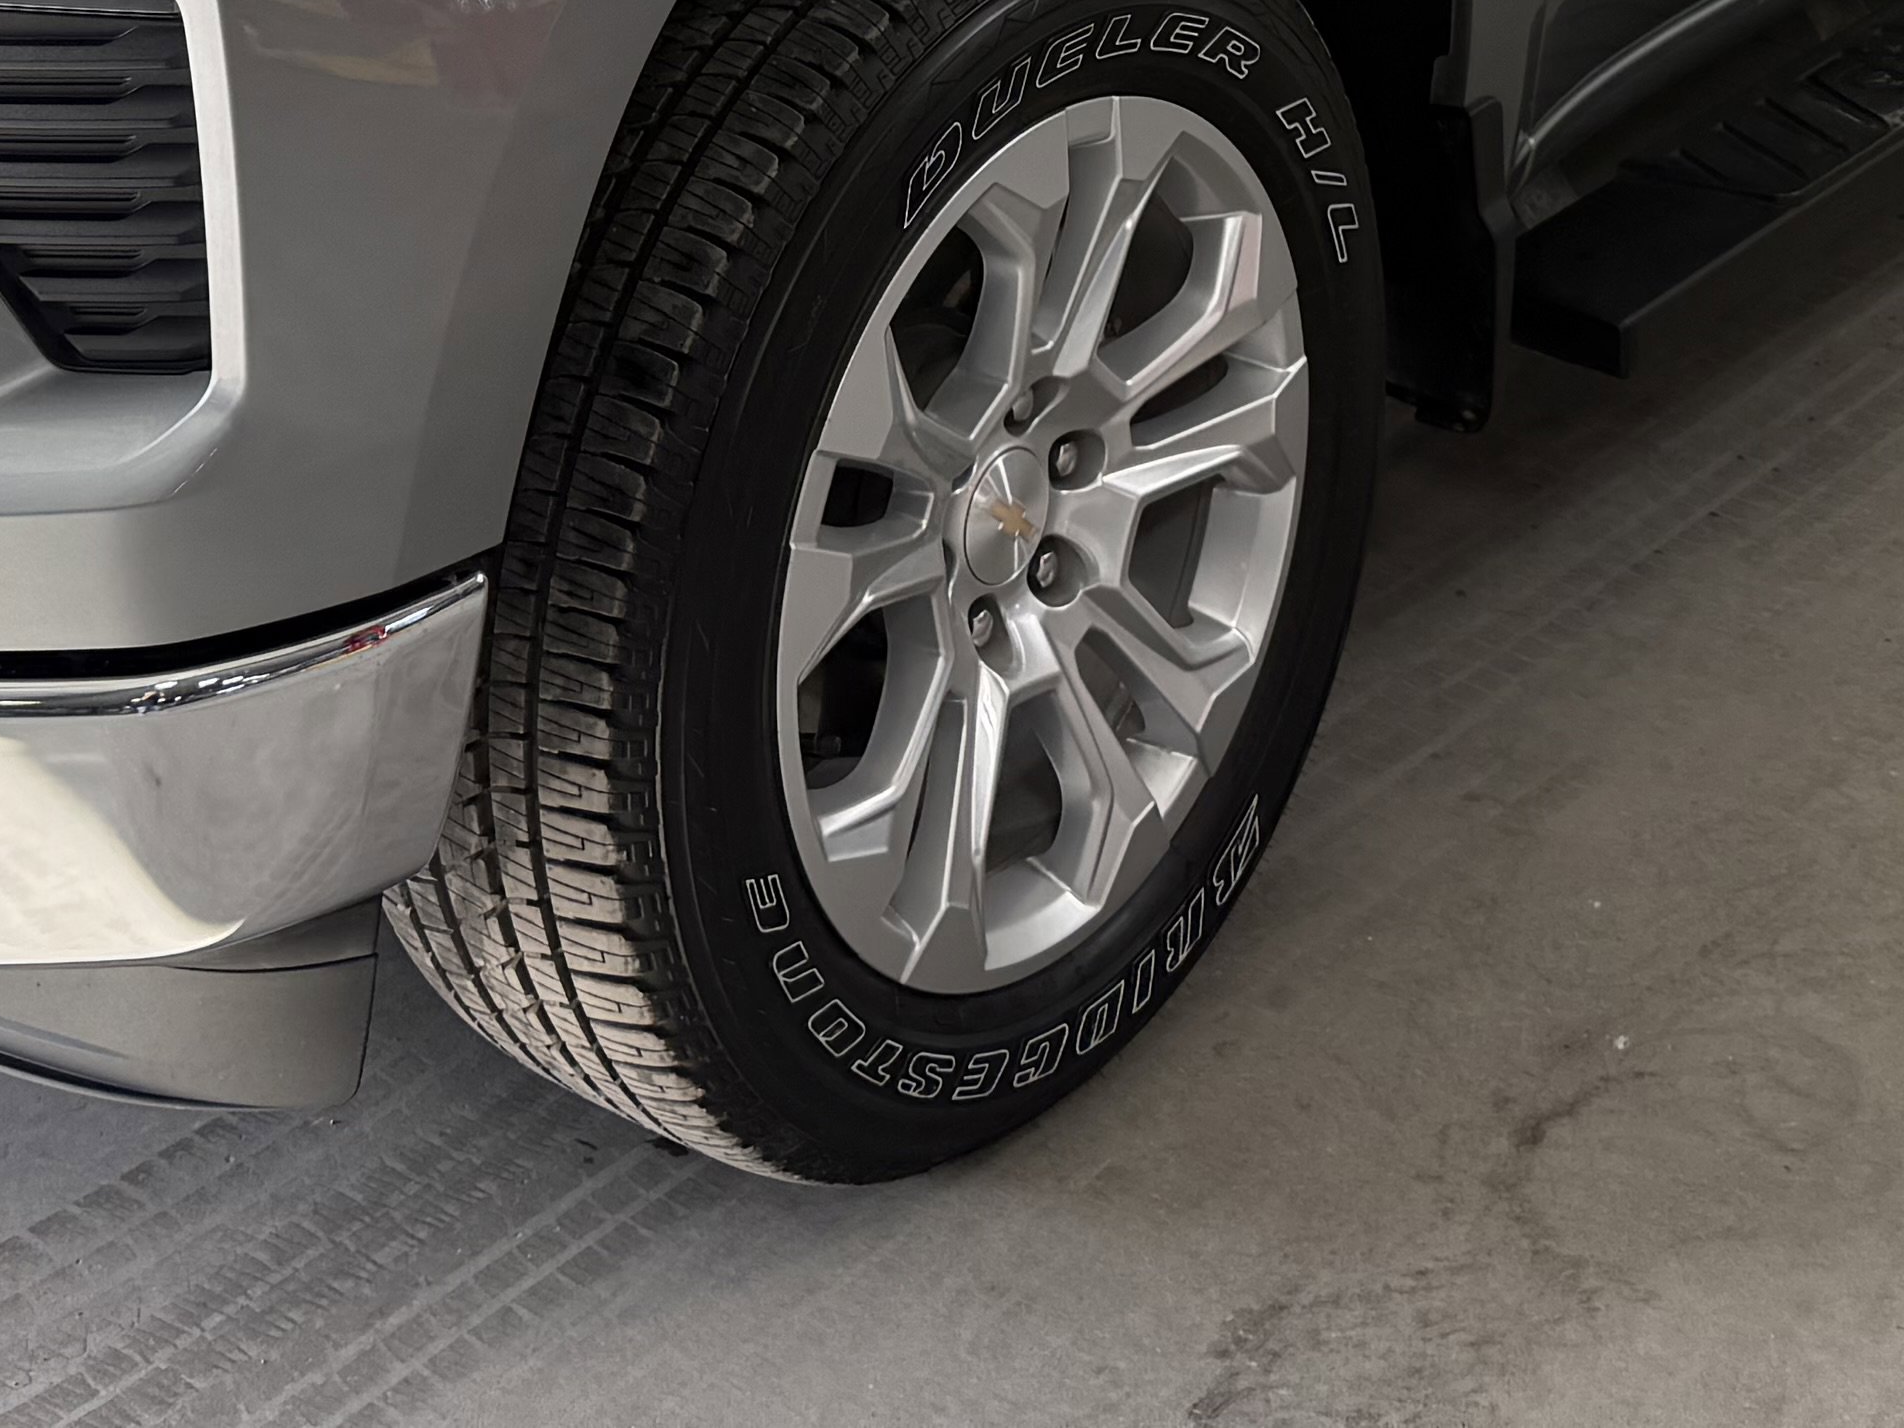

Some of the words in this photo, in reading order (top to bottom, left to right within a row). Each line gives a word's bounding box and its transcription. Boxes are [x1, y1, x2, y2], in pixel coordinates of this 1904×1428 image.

[903, 12, 1261, 229] DUELER
[1276, 97, 1361, 264] H/L
[746, 795, 1260, 1101] BRIDGESTONE
